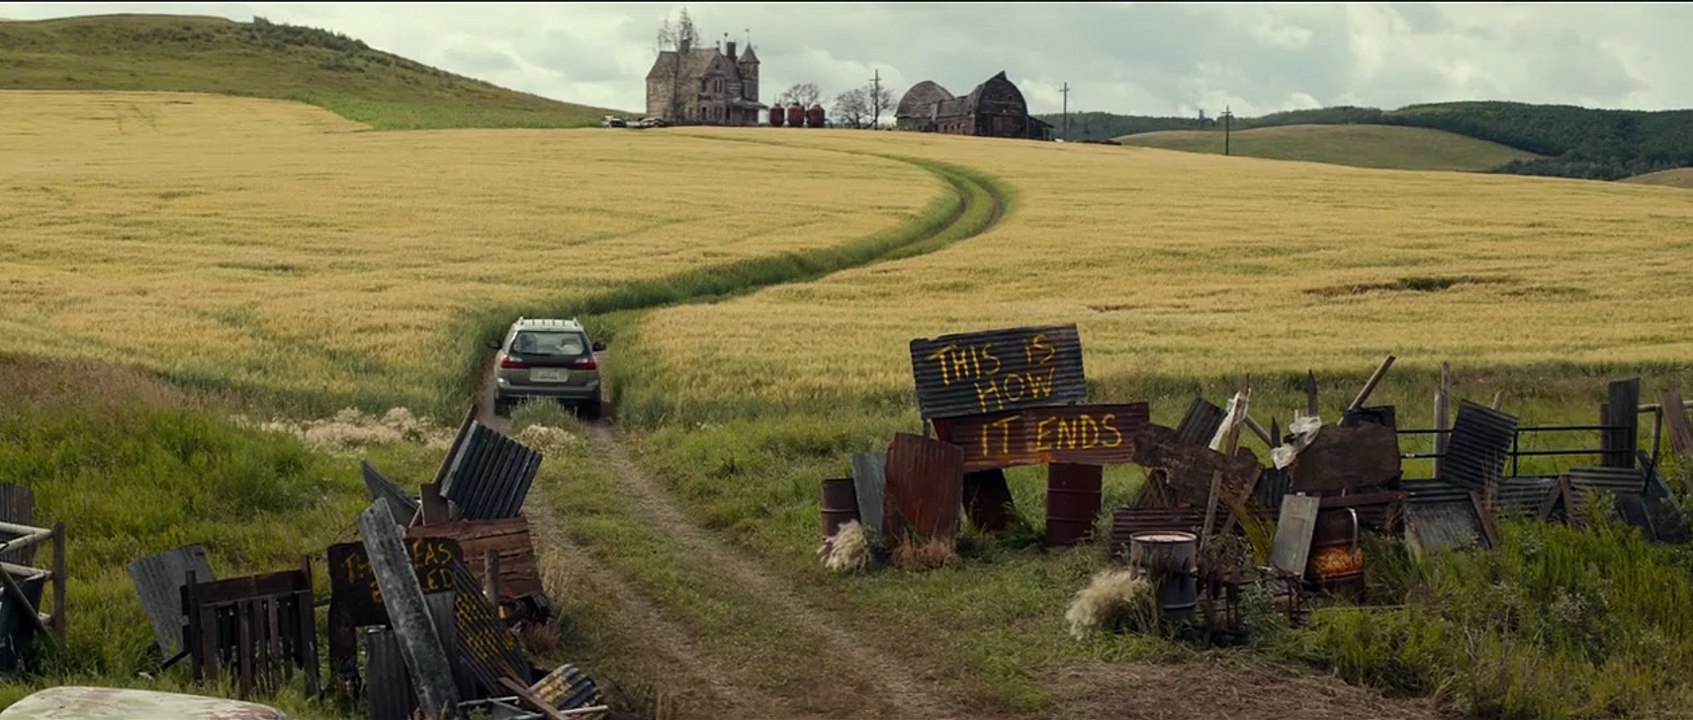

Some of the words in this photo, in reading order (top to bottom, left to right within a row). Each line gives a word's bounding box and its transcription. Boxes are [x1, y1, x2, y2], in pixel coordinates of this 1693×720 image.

[928, 342, 1001, 386] THIS
[1023, 333, 1056, 365] IS
[974, 366, 1056, 413] HOW
[981, 414, 1022, 457] IT
[1035, 412, 1123, 451] ENDS
